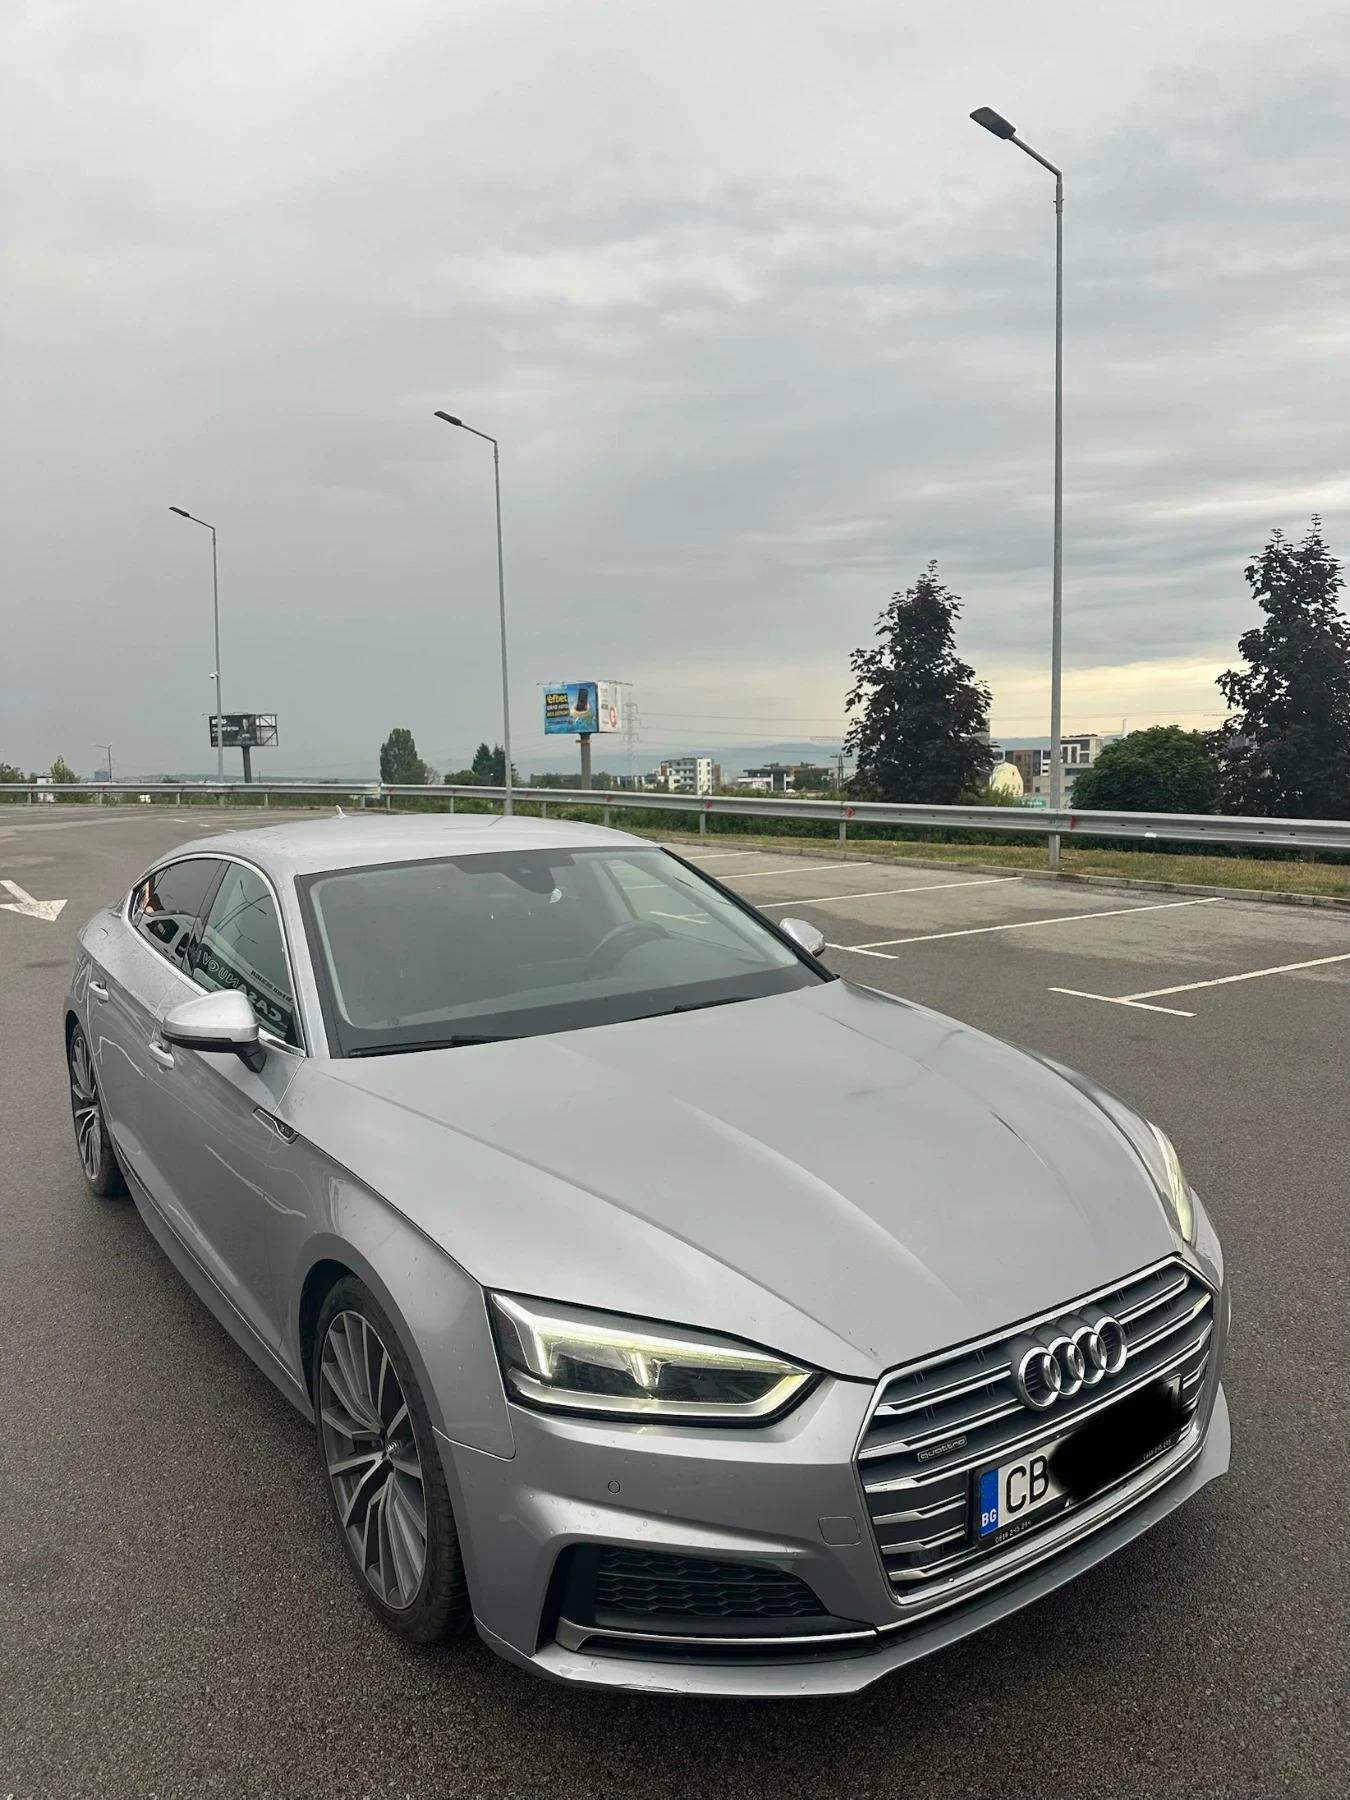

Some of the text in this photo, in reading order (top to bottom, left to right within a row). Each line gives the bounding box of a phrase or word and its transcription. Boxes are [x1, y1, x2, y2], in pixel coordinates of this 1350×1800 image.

[920, 1438, 965, 1459] quattro
[1006, 1454, 1049, 1514] CB
[981, 1508, 997, 1528] BG
